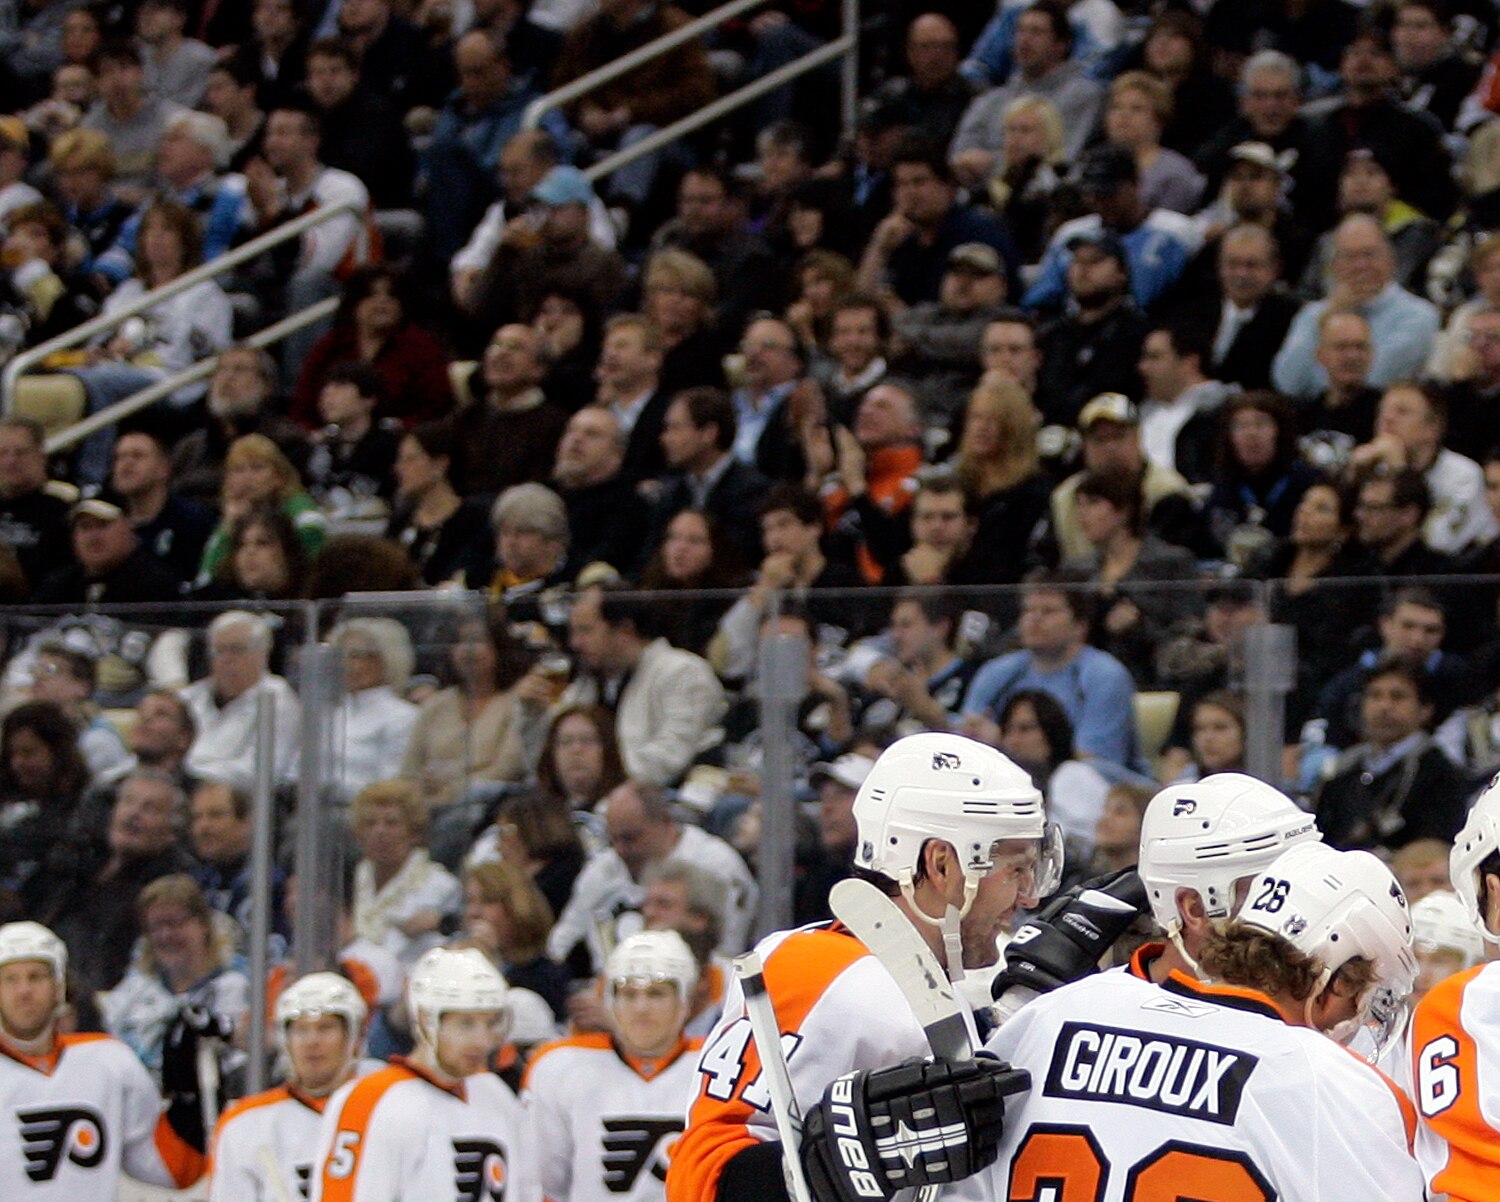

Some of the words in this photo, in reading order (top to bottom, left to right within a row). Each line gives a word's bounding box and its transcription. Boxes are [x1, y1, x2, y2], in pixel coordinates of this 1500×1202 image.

[1251, 877, 1291, 913] 28
[1061, 1030, 1238, 1115] GIROUX
[1418, 1034, 1461, 1119] 6
[329, 1130, 361, 1178] 5
